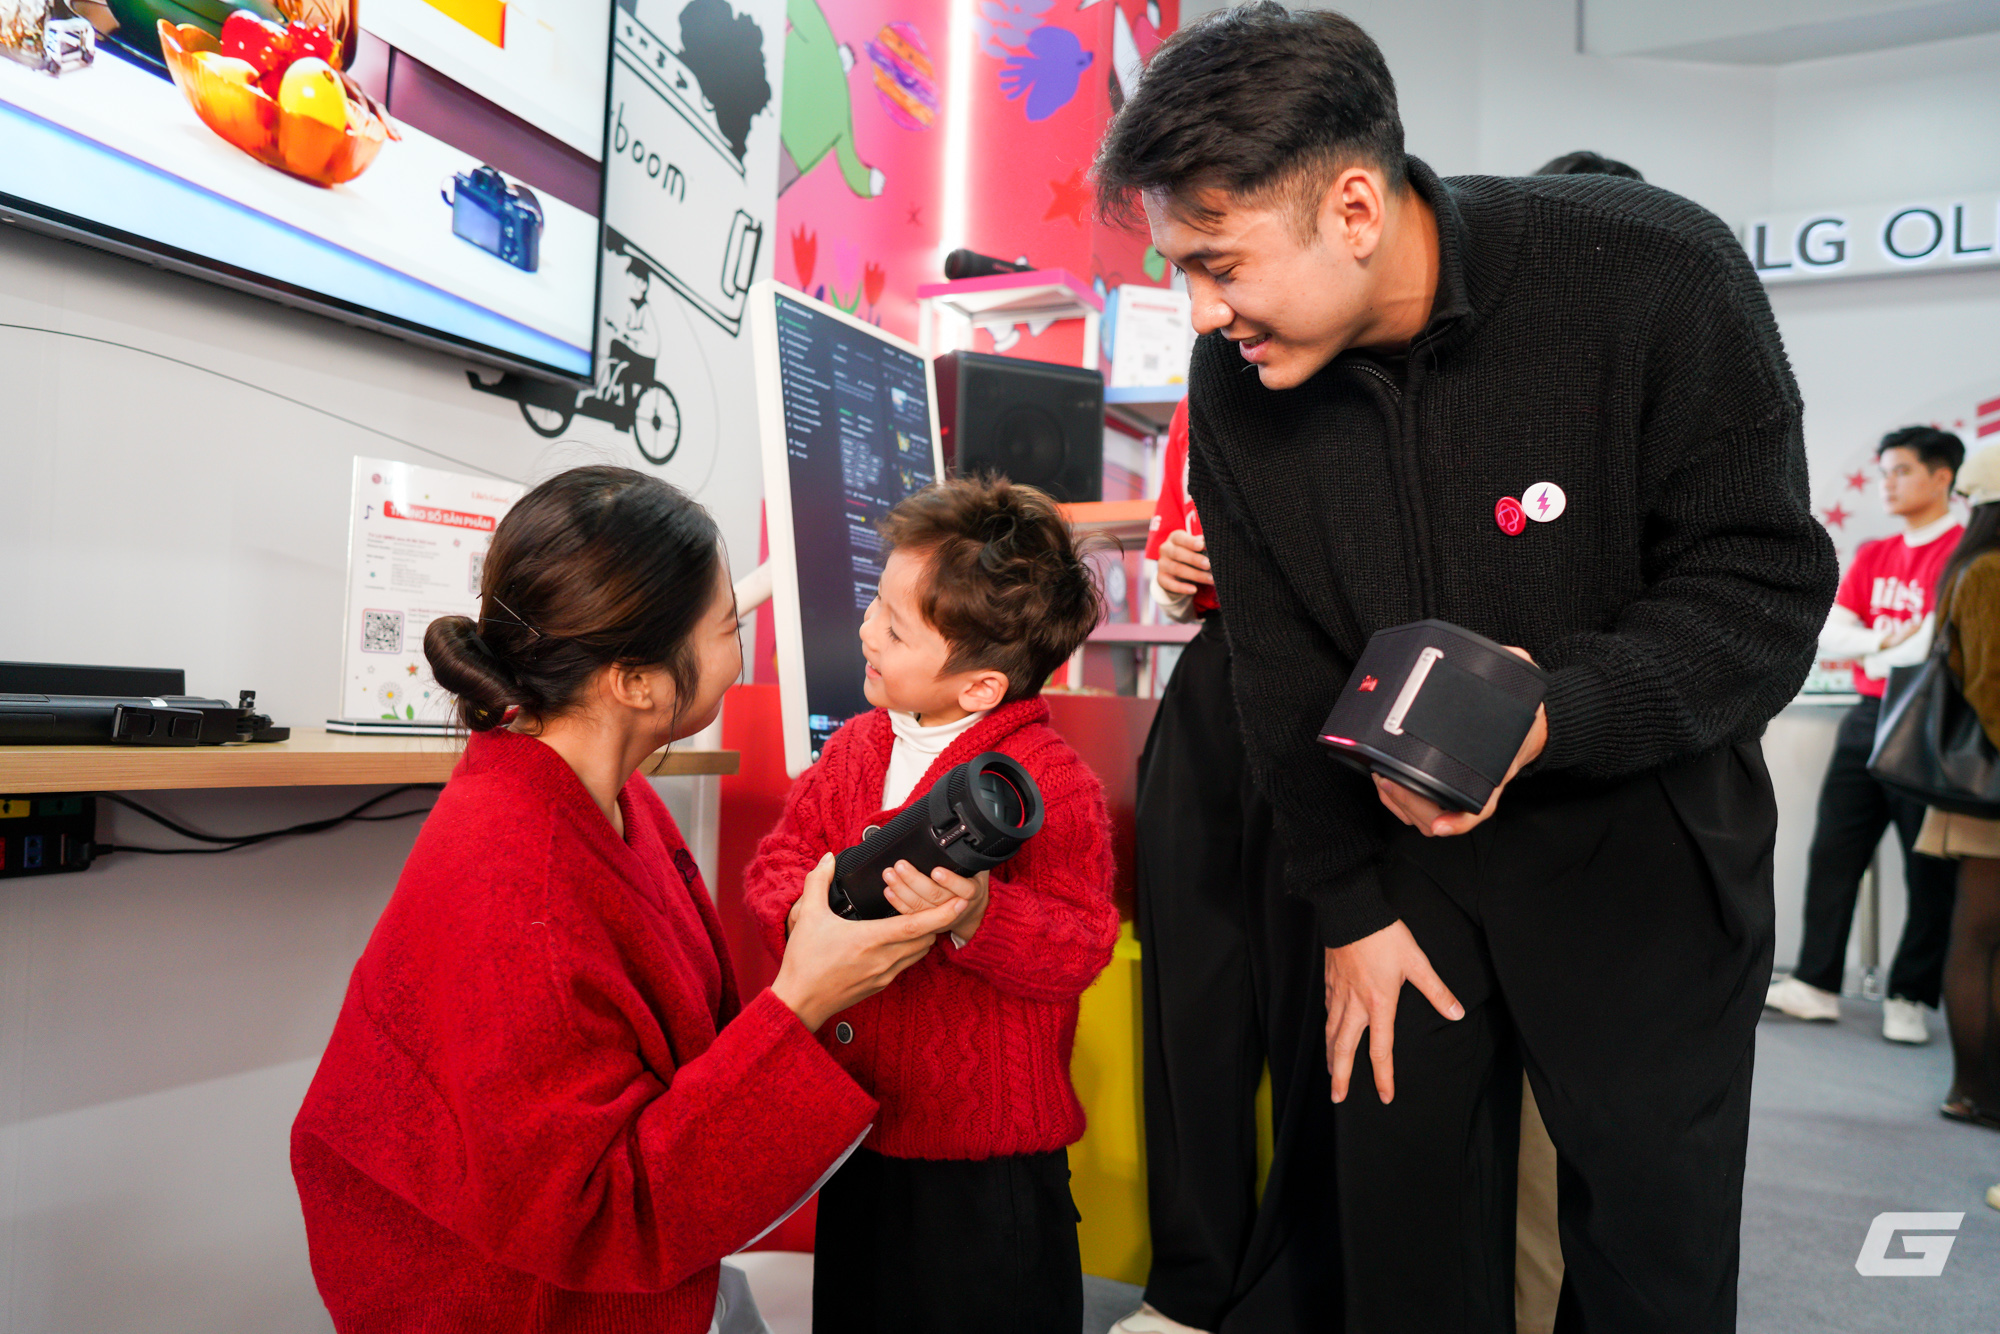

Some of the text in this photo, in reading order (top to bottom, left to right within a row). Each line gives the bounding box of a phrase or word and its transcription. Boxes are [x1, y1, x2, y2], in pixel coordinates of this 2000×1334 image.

[611, 101, 686, 204] boom
[1756, 206, 1993, 271] LG OL
